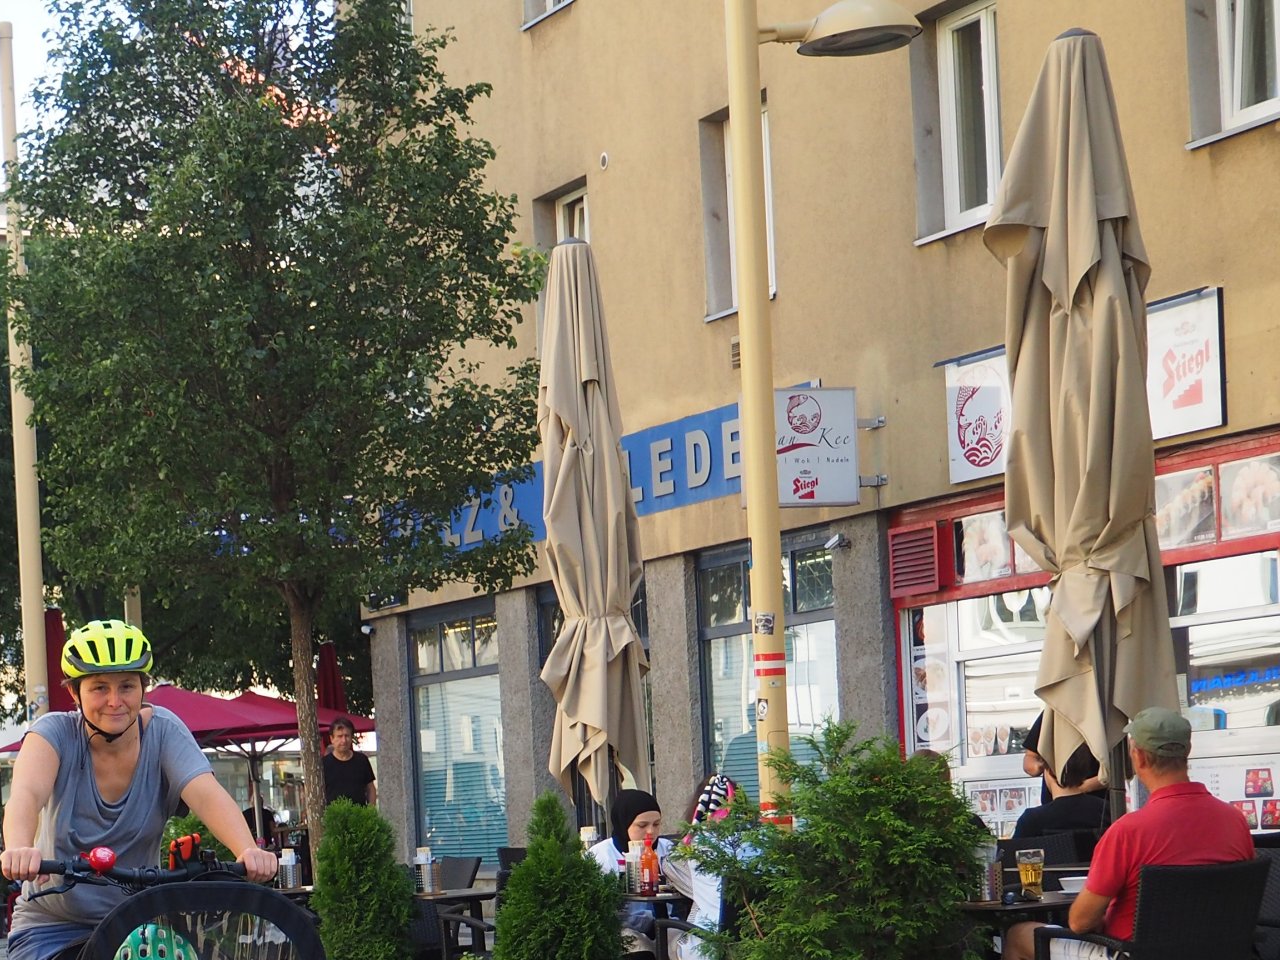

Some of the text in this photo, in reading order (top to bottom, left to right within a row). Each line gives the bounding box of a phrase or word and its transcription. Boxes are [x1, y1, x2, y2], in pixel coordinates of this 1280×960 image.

[1162, 338, 1210, 398] Stiegl
[778, 427, 851, 449] an Kee
[497, 483, 520, 531] &
[621, 418, 741, 503] LEDE
[793, 477, 818, 495] Stiegl
